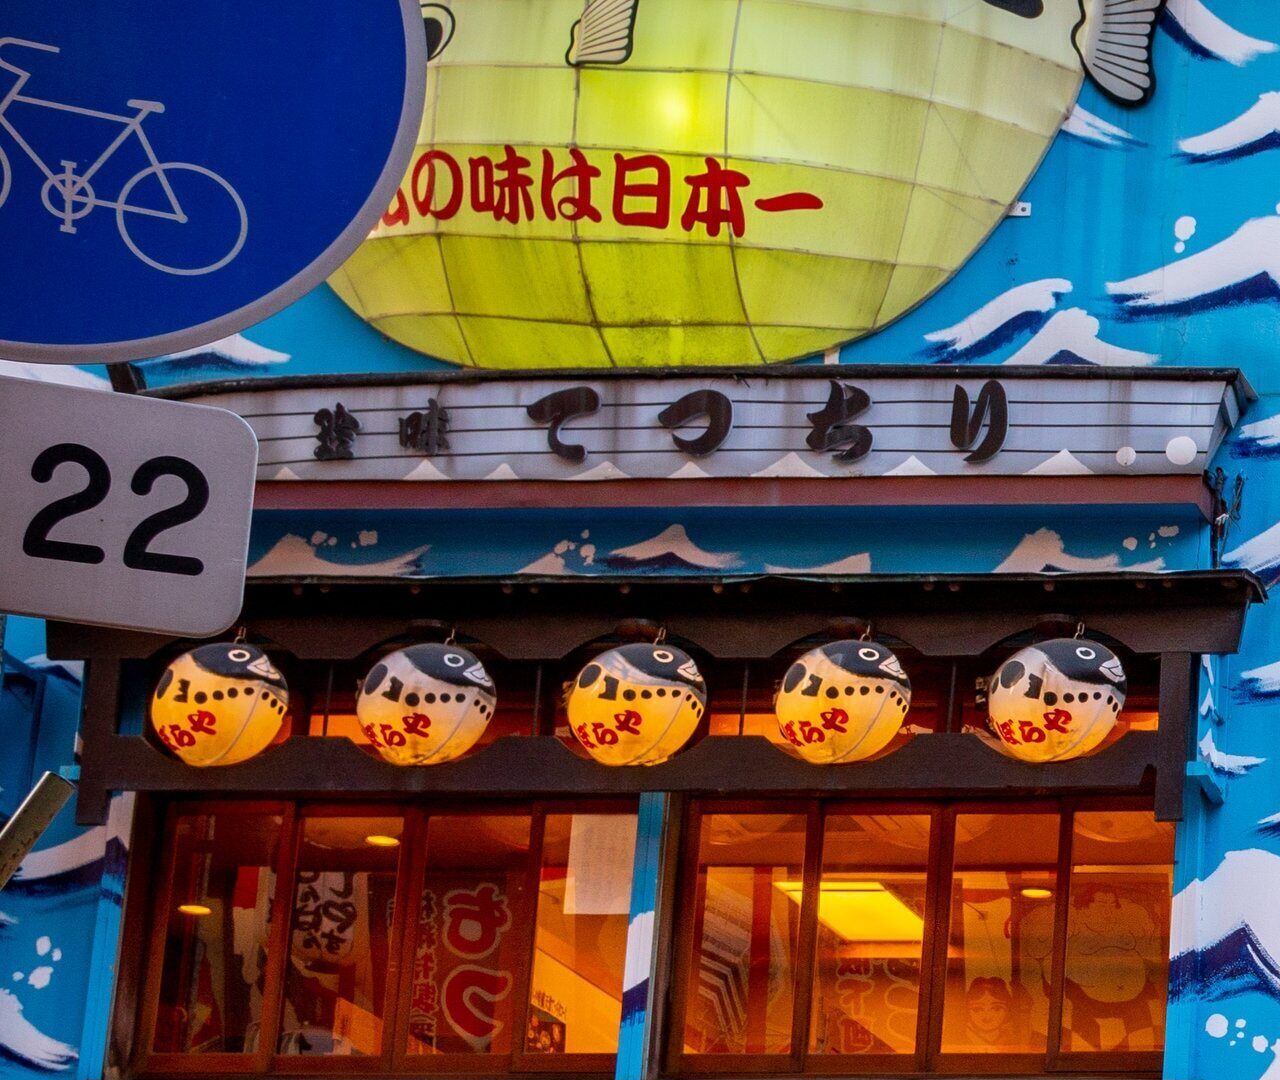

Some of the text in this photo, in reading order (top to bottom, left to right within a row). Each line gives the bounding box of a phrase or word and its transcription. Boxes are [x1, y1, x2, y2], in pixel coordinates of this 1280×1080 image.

[368, 144, 824, 239] の味は日本一
